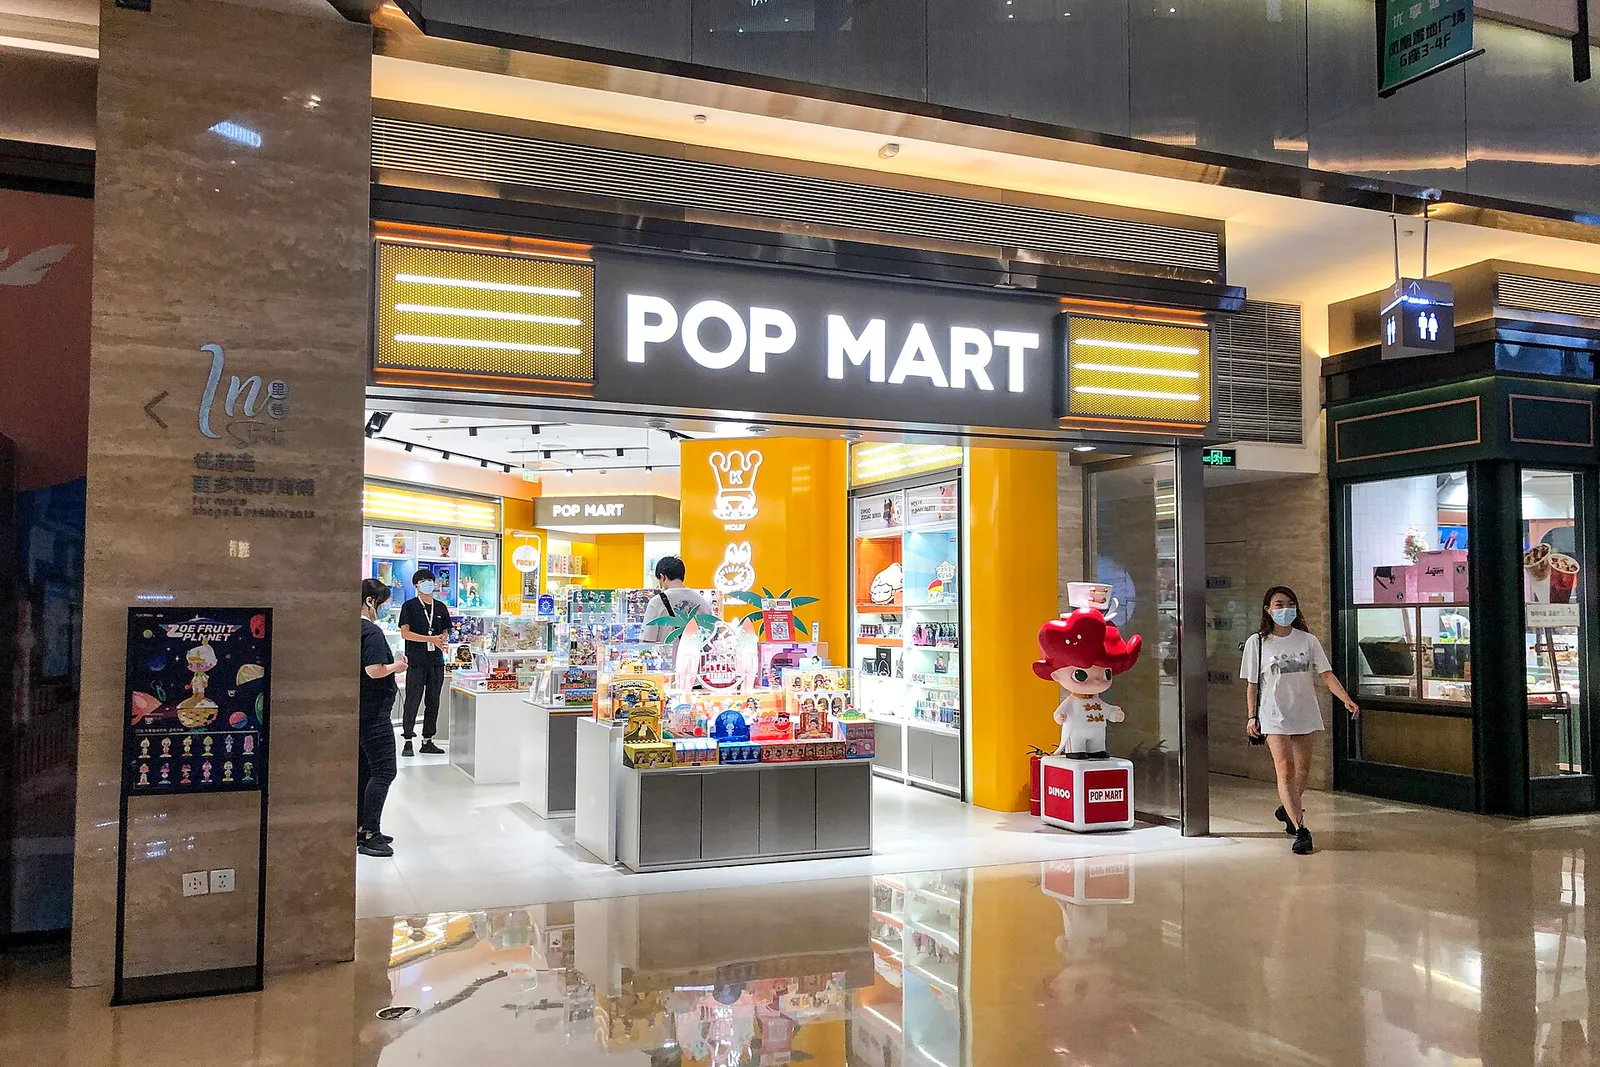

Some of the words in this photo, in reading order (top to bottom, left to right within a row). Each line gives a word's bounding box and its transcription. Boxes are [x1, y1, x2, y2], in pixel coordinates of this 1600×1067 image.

[626, 294, 797, 373] POP
[827, 314, 1039, 393] MART
[729, 470, 744, 485] K
[553, 504, 581, 517] POP
[584, 503, 624, 517] MART
[516, 559, 536, 567] PUCKY
[167, 624, 195, 638] ZOE
[197, 624, 233, 634] FRUIT
[1048, 785, 1071, 799] DIMOO
[1090, 789, 1103, 801] POP
[1104, 787, 1123, 800] MART
